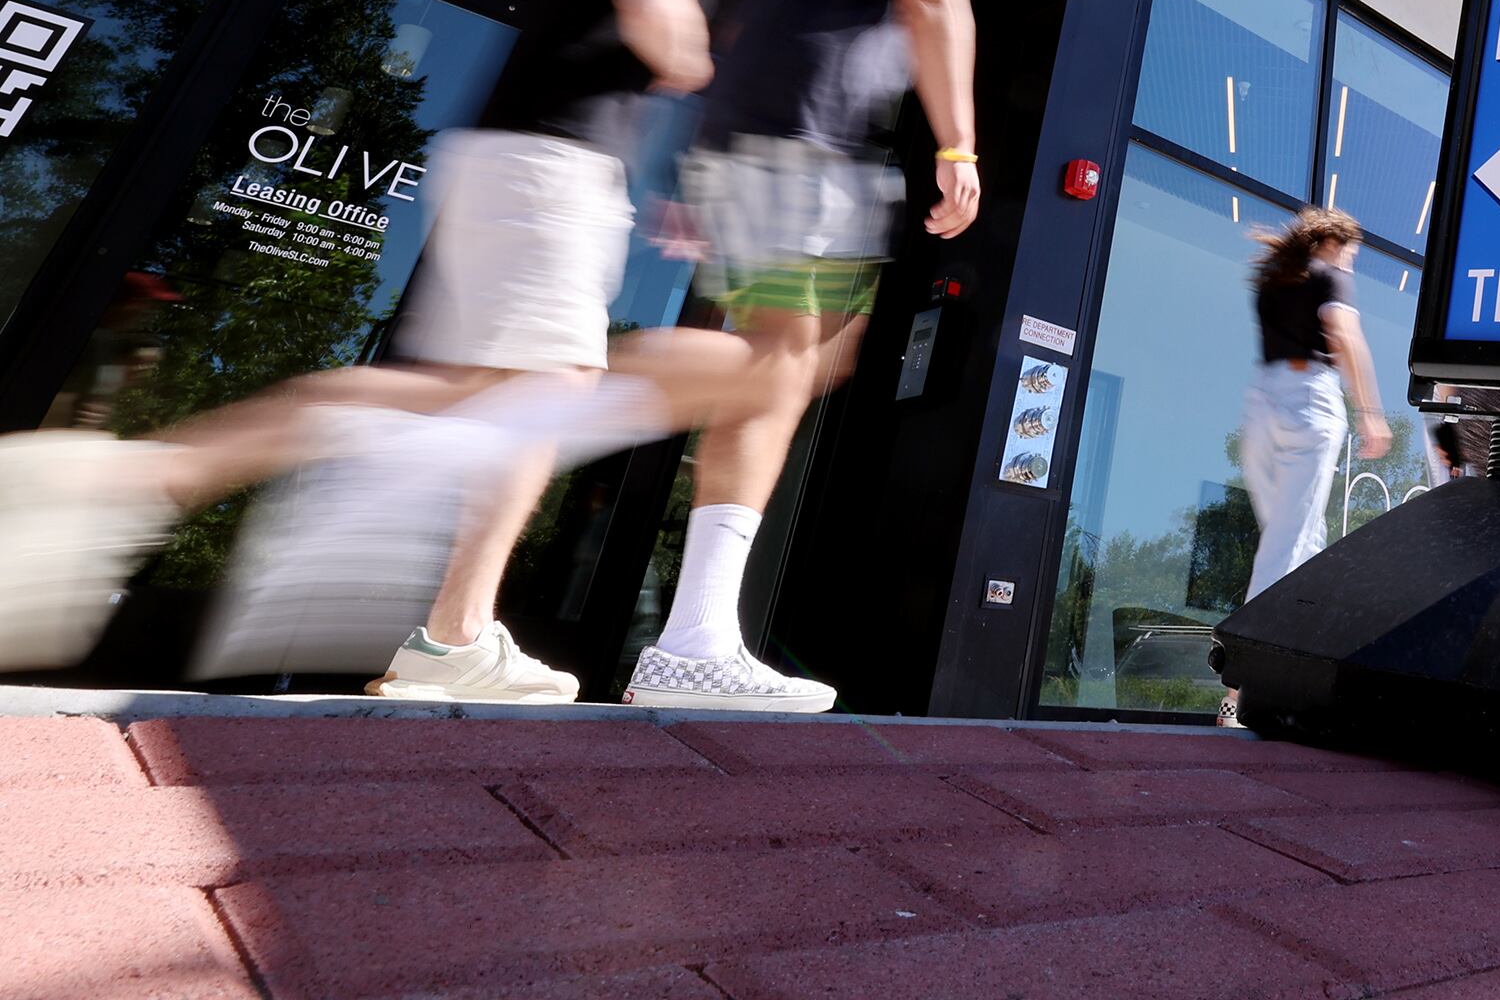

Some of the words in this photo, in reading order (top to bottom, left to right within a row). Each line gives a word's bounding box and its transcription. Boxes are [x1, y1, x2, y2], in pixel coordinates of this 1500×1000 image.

[262, 95, 310, 126] the
[249, 126, 427, 201] OLIVE
[231, 175, 322, 215] Leasing
[326, 198, 390, 232] Office
[212, 200, 254, 220] Monday
[260, 212, 292, 229] Friday
[296, 221, 319, 235] 9:00
[319, 227, 336, 239] am
[342, 232, 365, 246] 6:00
[363, 239, 381, 250] pm
[241, 219, 287, 240] Saturday
[291, 232, 321, 247] 10:00
[319, 239, 336, 251] am
[343, 244, 366, 258] 4:00
[364, 251, 382, 262] pm
[249, 240, 329, 267] TheOliveSLC.com
[1023, 328, 1065, 346] CONNECTION
[1033, 321, 1074, 340] DEPARTMENT
